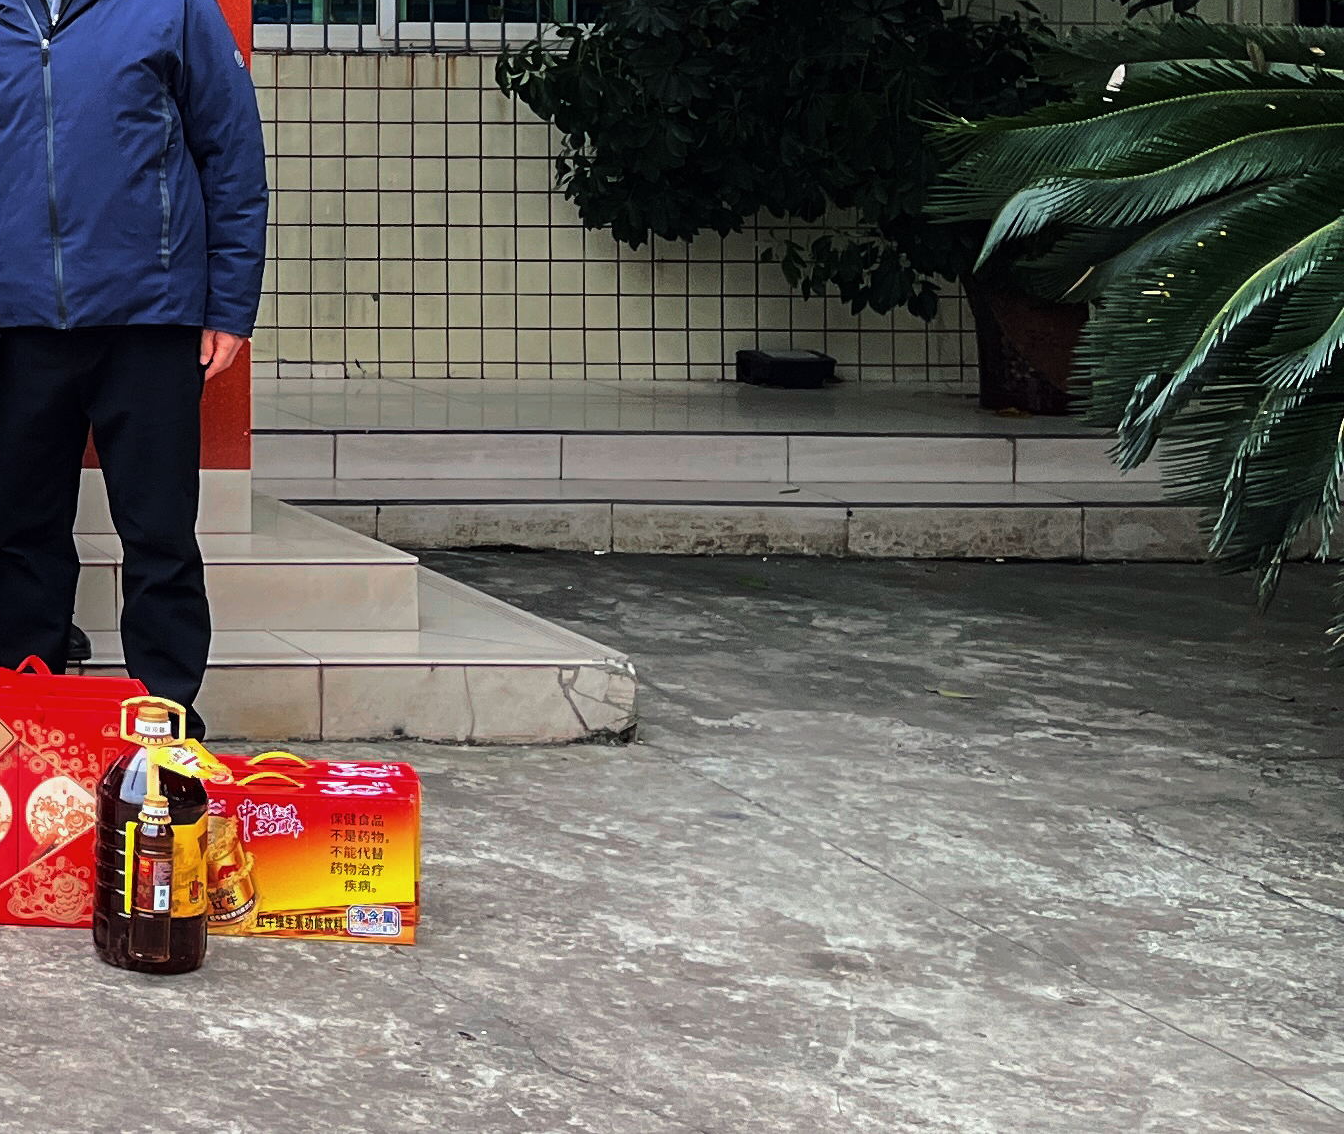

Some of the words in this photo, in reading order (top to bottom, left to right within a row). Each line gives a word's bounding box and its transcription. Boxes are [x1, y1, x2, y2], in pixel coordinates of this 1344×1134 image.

[330, 813, 384, 826] 保健食品
[330, 846, 384, 860] 不能代替
[330, 862, 384, 876] 药物治疗
